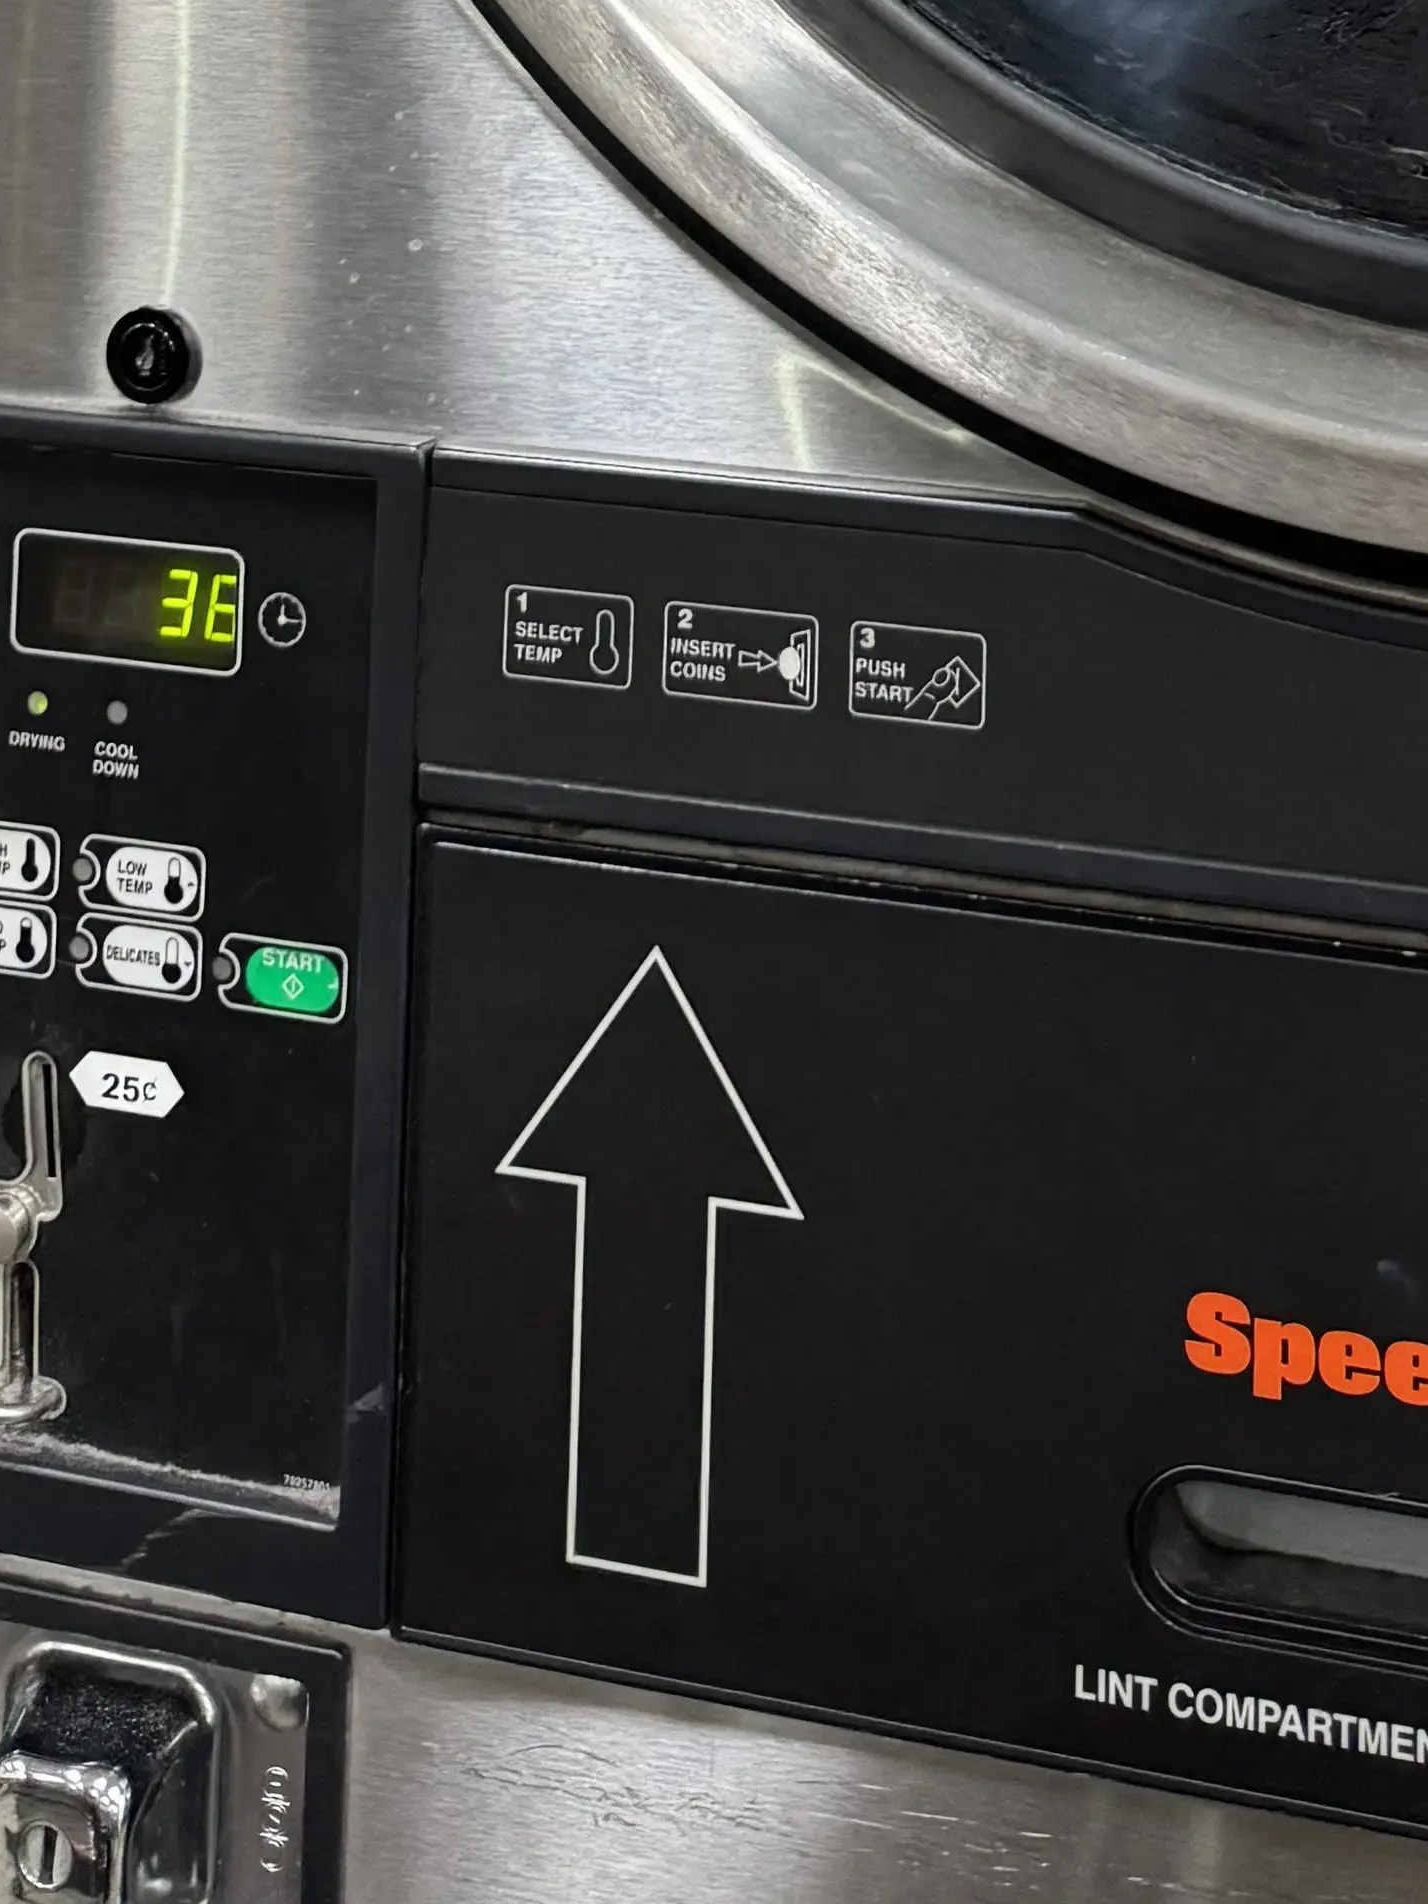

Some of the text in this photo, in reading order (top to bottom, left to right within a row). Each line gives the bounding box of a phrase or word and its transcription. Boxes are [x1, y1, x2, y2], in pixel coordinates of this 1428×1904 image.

[159, 568, 237, 642] 36
[516, 592, 528, 612] 1
[677, 609, 694, 630] 2
[515, 621, 584, 645] SELECT
[860, 628, 875, 649] 3
[514, 643, 563, 664] TEMP
[670, 637, 735, 662] INSERT
[669, 660, 727, 683] COINS
[855, 657, 906, 680] PUSH
[854, 682, 915, 704] START
[8, 730, 66, 752] DRYING
[94, 740, 138, 760] COOL
[92, 759, 139, 780] DOWN
[117, 860, 148, 877] LOW
[117, 878, 154, 895] TEMP
[106, 943, 161, 967] DELICATES
[262, 947, 325, 975] START
[100, 1073, 158, 1104] 25¢
[1074, 1664, 1158, 1712] LINT
